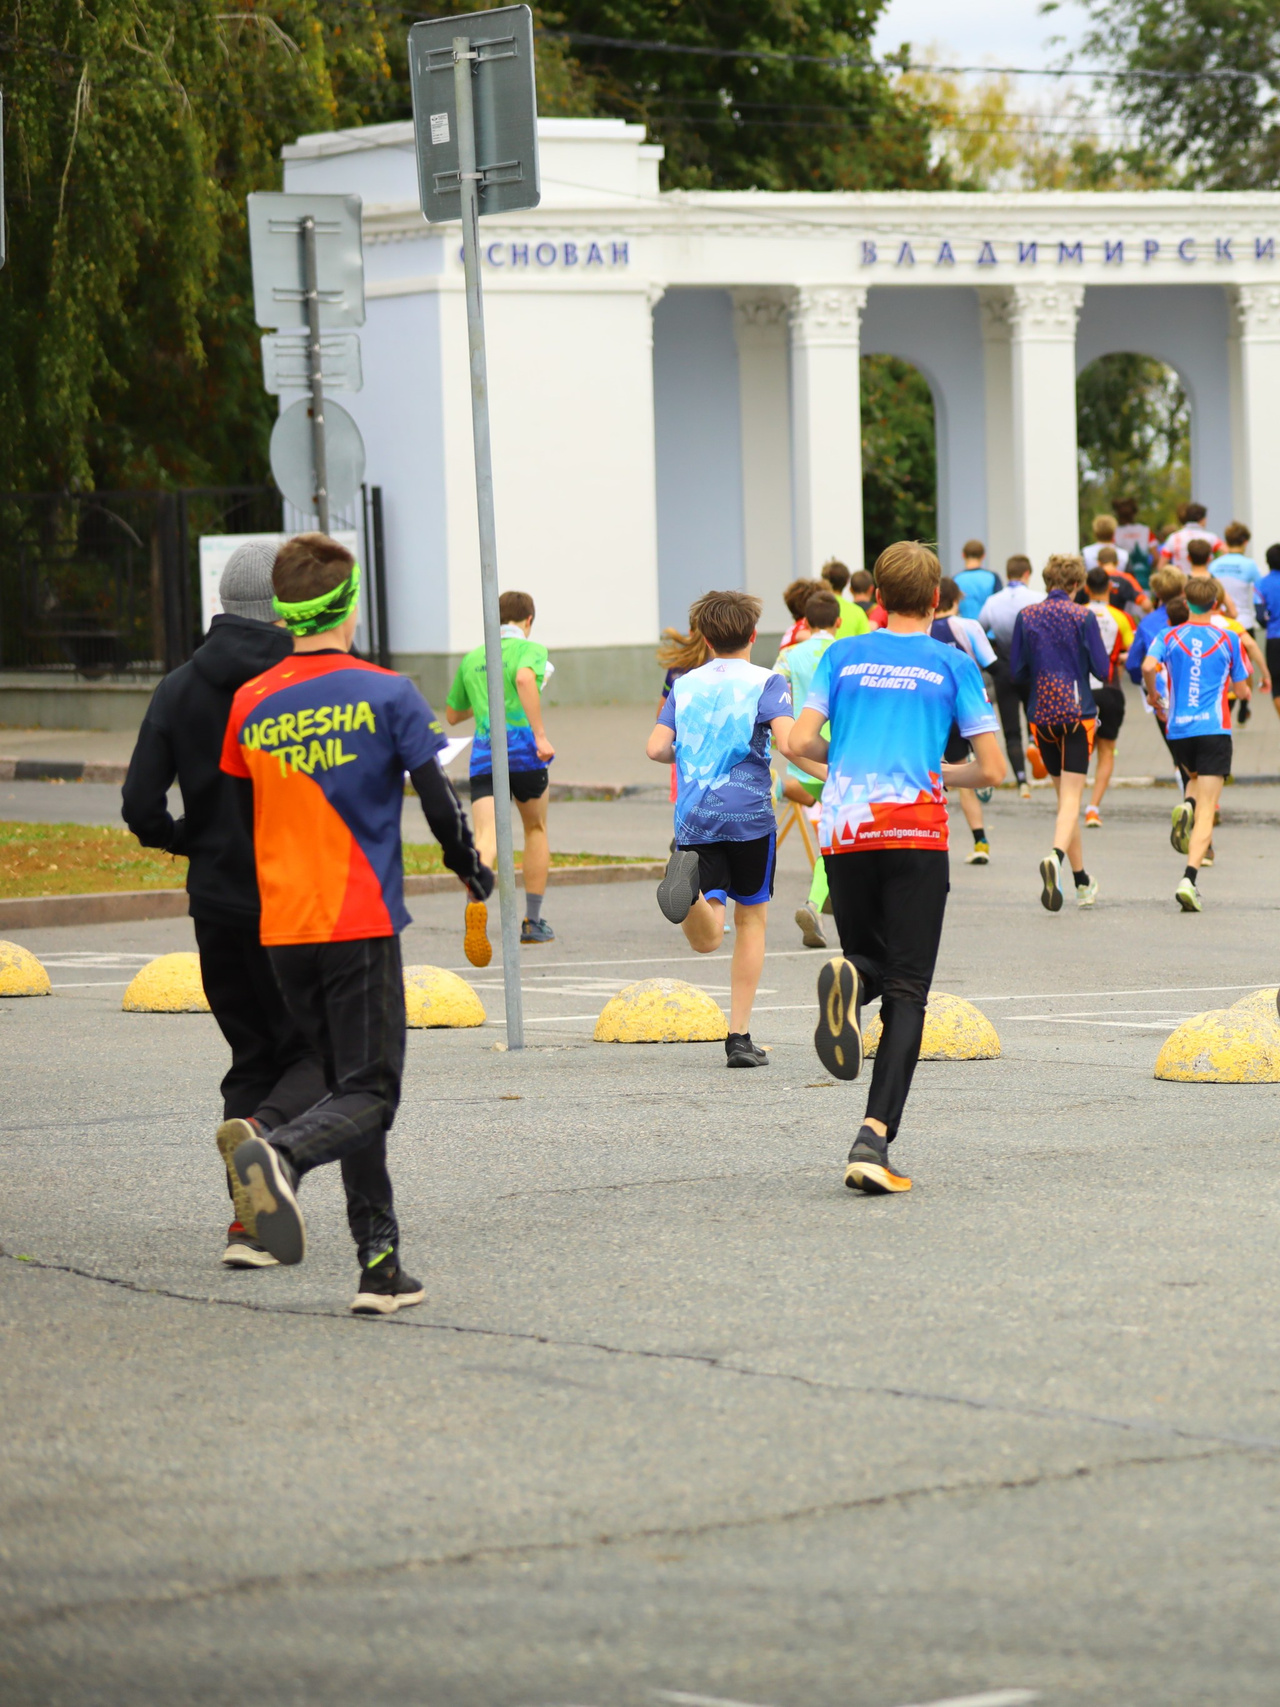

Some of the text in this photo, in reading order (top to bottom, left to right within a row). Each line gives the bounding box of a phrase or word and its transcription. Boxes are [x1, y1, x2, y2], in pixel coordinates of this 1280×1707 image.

[839, 663, 945, 686] ВОЛГОГРАДСКАЯ
[859, 675, 918, 691] ОБЛАСТЬ
[243, 701, 377, 751] UGRESHA
[270, 738, 358, 779] TRAIL
[859, 828, 941, 839] www.volgoorient.ru
